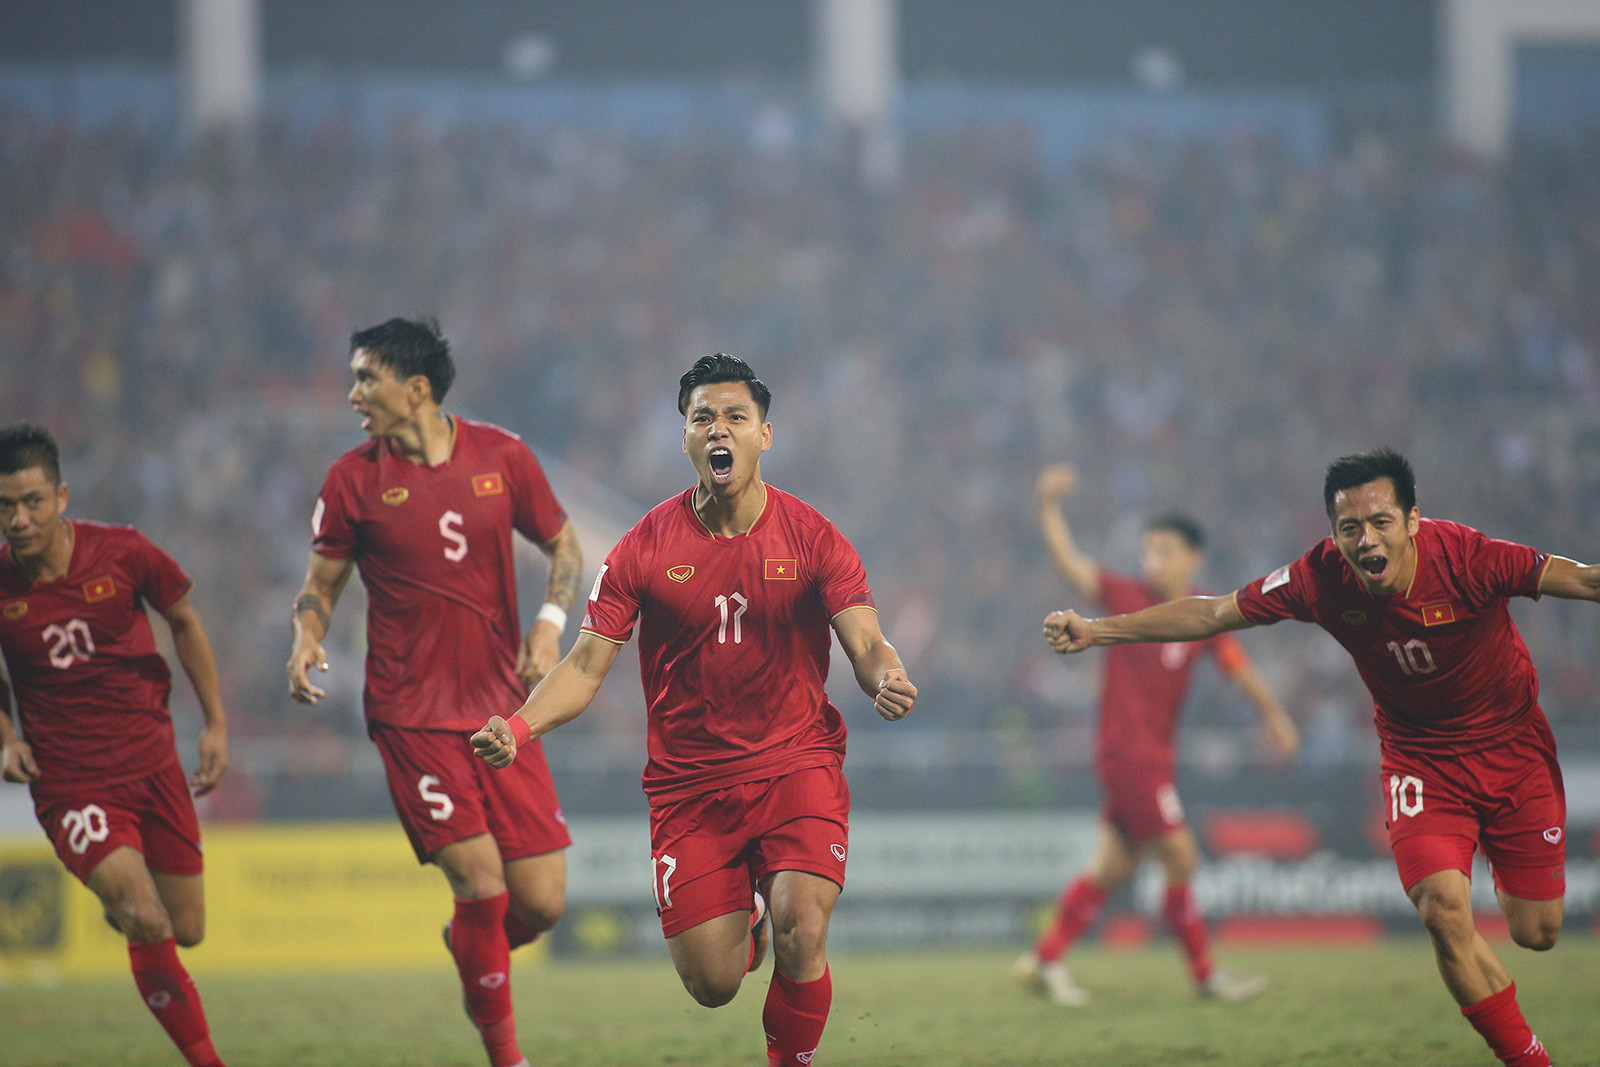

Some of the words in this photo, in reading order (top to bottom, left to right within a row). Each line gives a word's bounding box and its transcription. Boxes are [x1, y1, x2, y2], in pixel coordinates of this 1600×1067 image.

[714, 591, 748, 644] 17
[42, 618, 96, 670] 20
[1386, 638, 1438, 676] 10
[1390, 774, 1424, 822] 10
[62, 803, 110, 854] 20
